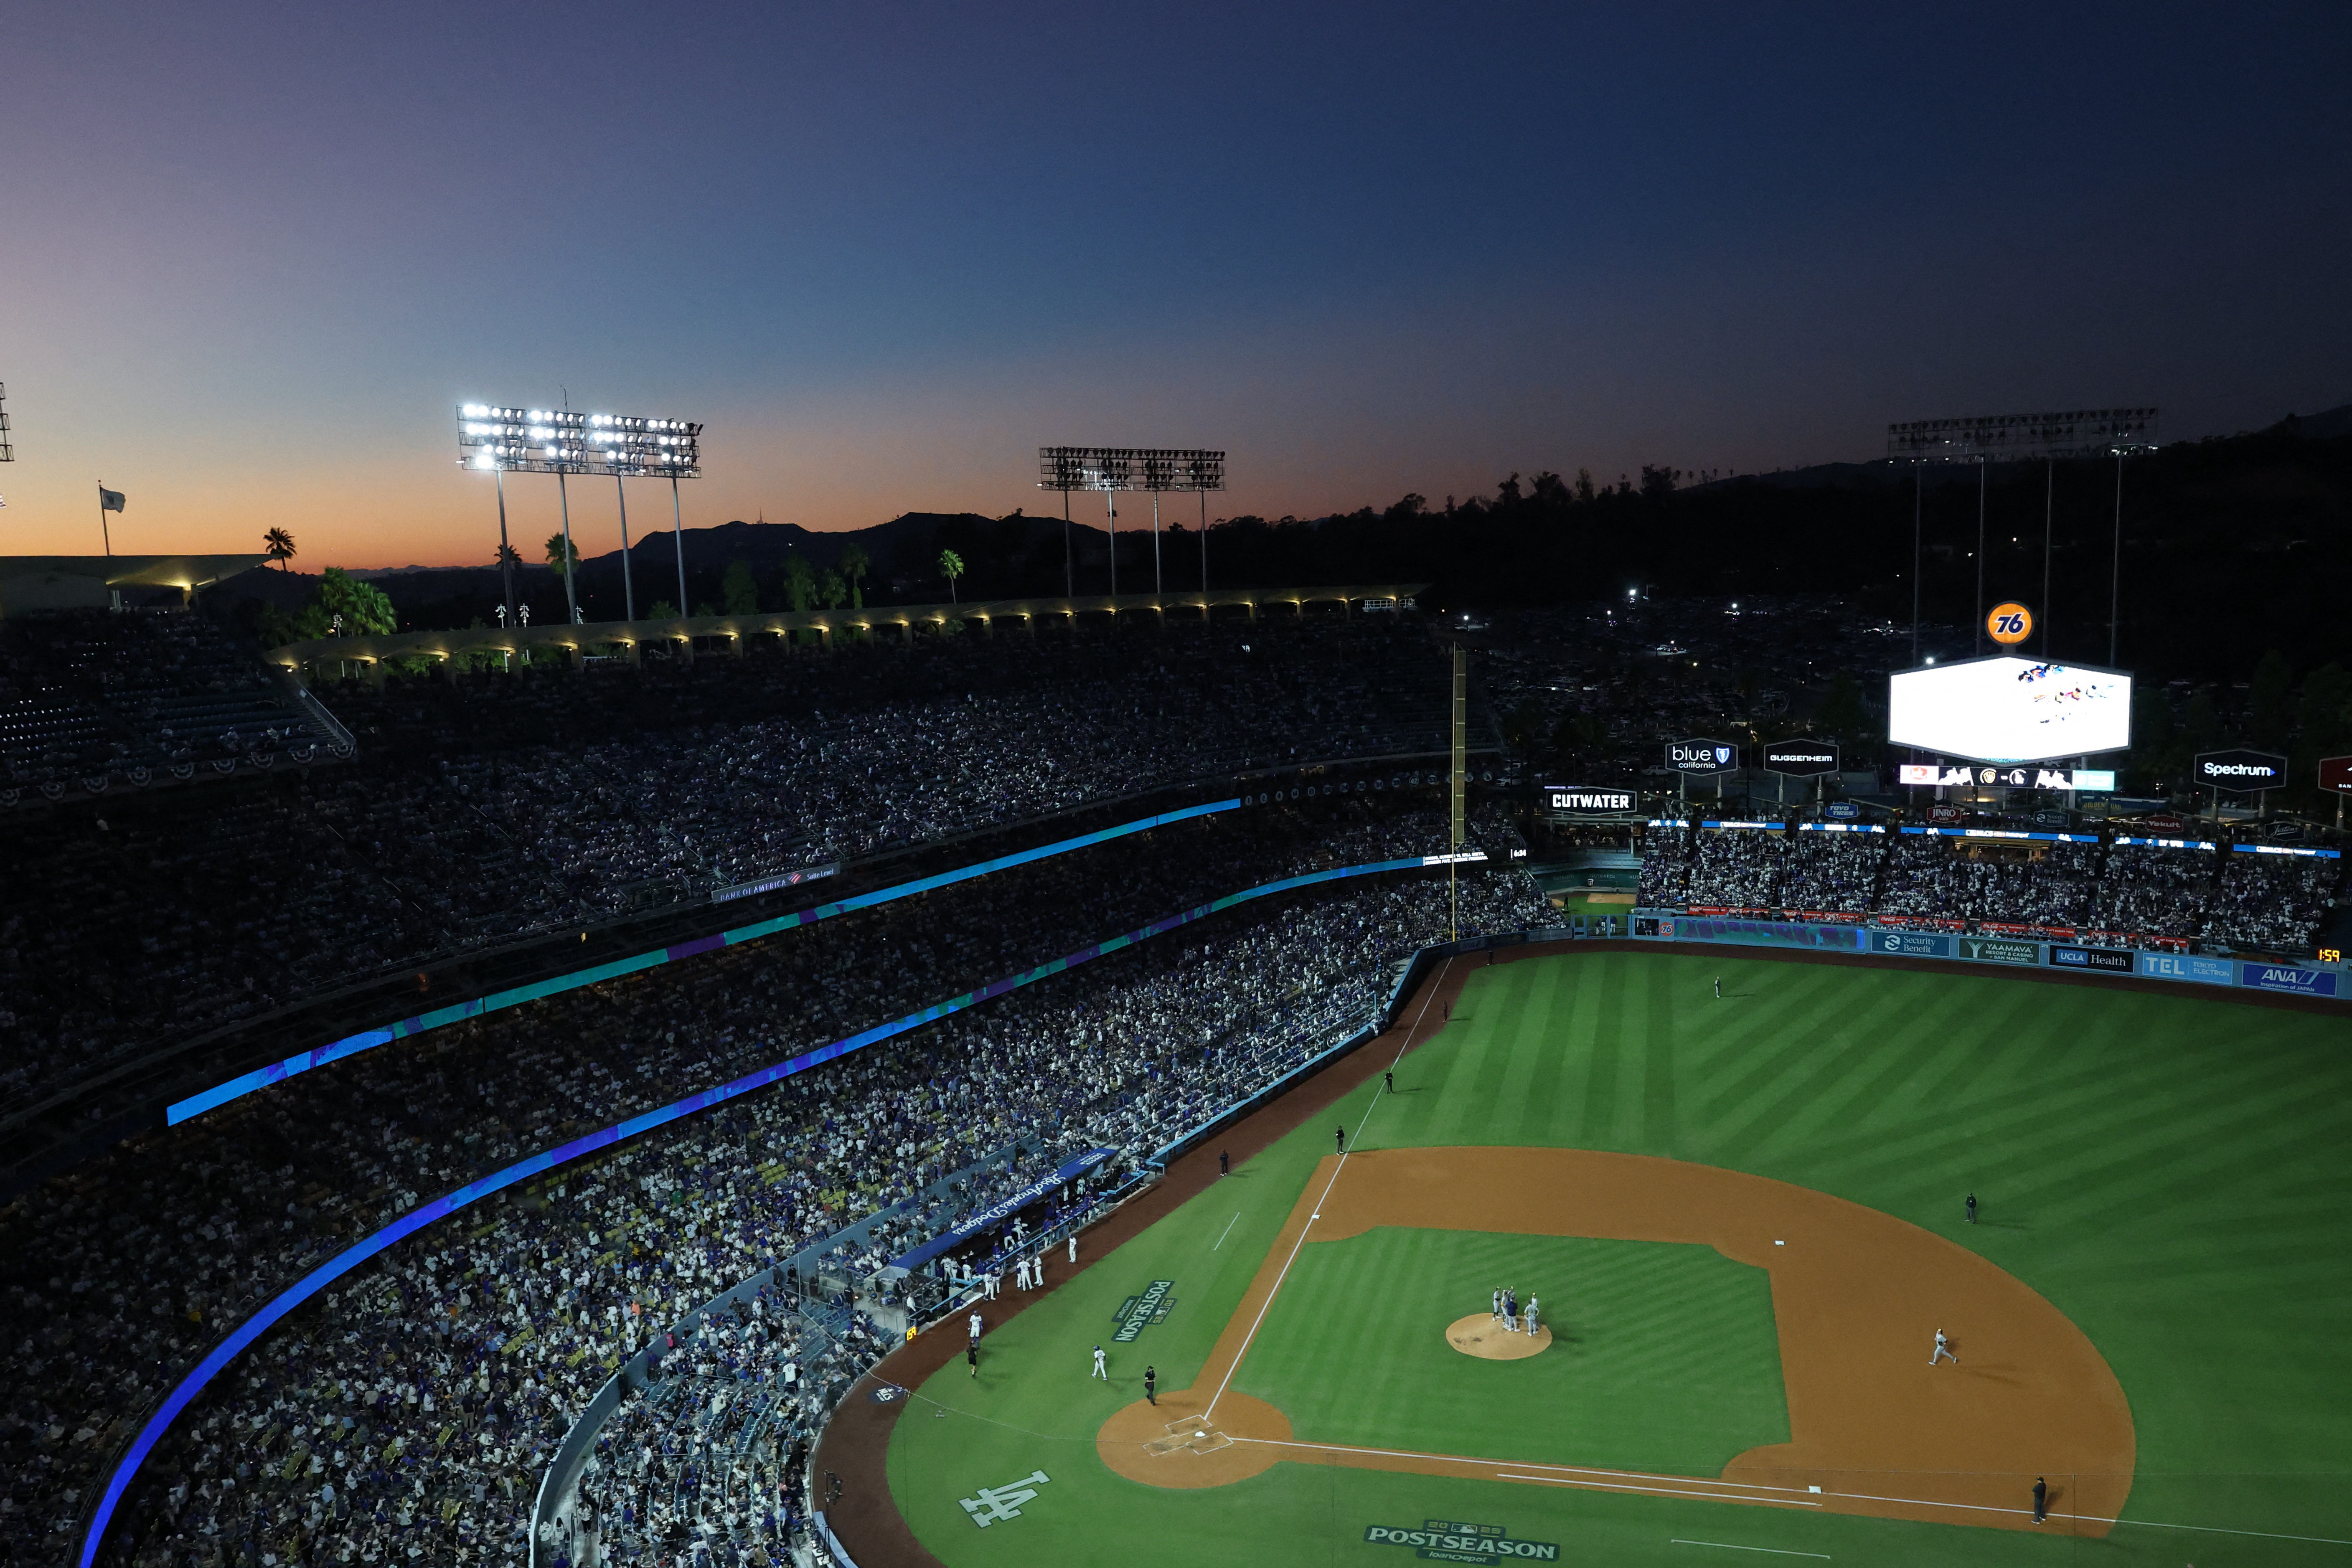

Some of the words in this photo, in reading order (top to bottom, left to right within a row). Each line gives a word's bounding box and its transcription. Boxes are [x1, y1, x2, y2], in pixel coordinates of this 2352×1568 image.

[1994, 612, 2025, 635] 76
[1672, 746, 1712, 761] blue
[2204, 762, 2271, 776] Spectrum
[1552, 794, 1629, 808] CUTWATER
[1933, 809, 1956, 818] JINRO
[807, 871, 820, 880] Suite
[820, 868, 834, 878] Level
[720, 891, 741, 901] BANK
[742, 888, 753, 896] OF
[754, 879, 786, 893] AMERICA
[1661, 925, 1672, 933] 76
[1904, 936, 1936, 946] Security
[2060, 952, 2084, 962] UCLA
[2090, 954, 2126, 967] Health
[2319, 949, 2340, 962] 1:59
[2146, 957, 2185, 975] TEL
[2193, 968, 2230, 977] ELECTRON
[2261, 969, 2298, 983] ANA
[1042, 1173, 1066, 1185] Los
[999, 1183, 1044, 1209] Angeles
[952, 1207, 1008, 1236] Dodgers
[1115, 1281, 1171, 1341] POSTSEASON
[878, 1388, 894, 1401] NLCS
[958, 1469, 1052, 1529] LA
[1368, 1527, 1555, 1559] POSTSEASON
